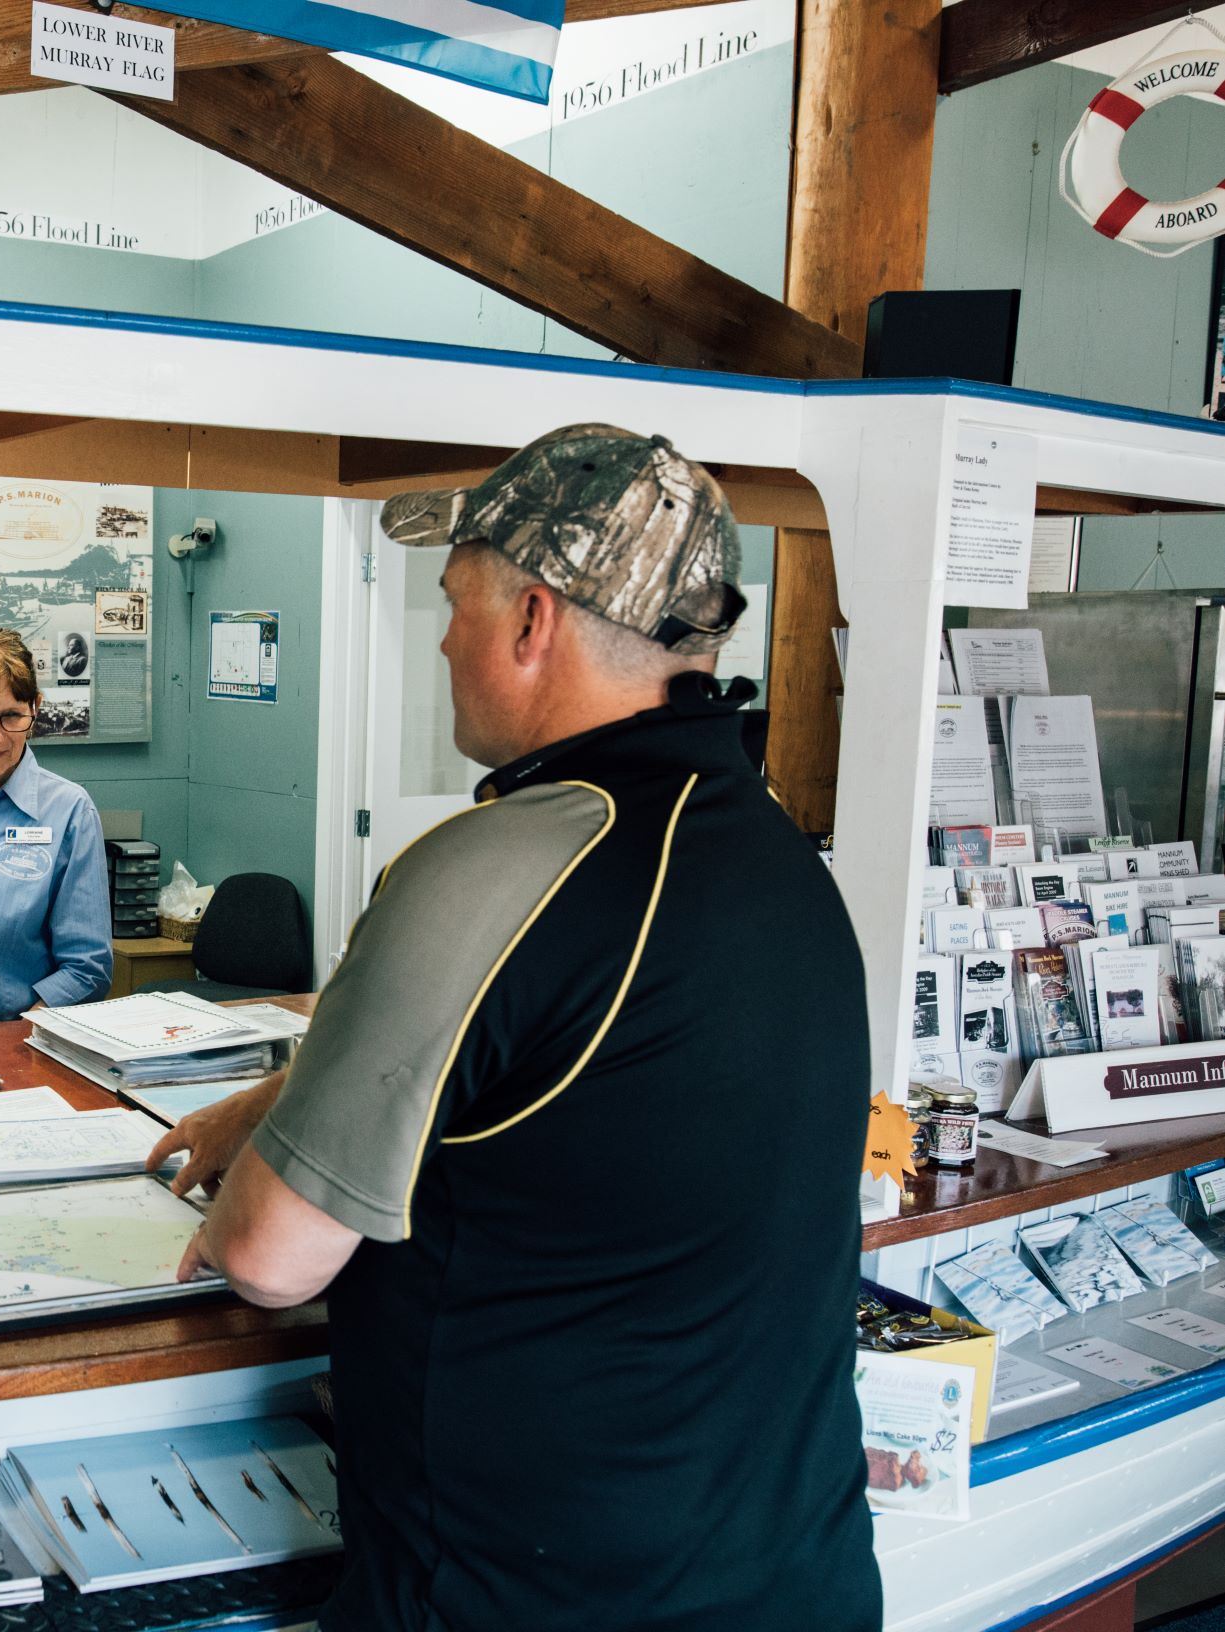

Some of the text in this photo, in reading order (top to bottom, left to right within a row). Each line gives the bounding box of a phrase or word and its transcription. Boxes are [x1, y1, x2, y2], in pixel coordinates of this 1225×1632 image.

[42, 17, 164, 55] LOWER RIVER
[40, 45, 165, 83] MURRAY FLAG
[563, 30, 758, 119] 1956 Flood Line
[1134, 61, 1220, 94] WELCOME
[255, 195, 326, 235] 1956 Floo
[1155, 202, 1218, 229] ABOARD
[31, 215, 89, 244] Flood
[95, 223, 139, 251] Line
[17, 490, 62, 506] MARION
[1157, 849, 1184, 858] MANNUM
[1104, 891, 1129, 900] MANNUM
[949, 923, 968, 932] EATING
[1065, 926, 1097, 938] MARION
[950, 936, 969, 945] PLACES
[1121, 1066, 1198, 1091] Mannum
[871, 1149, 891, 1160] each
